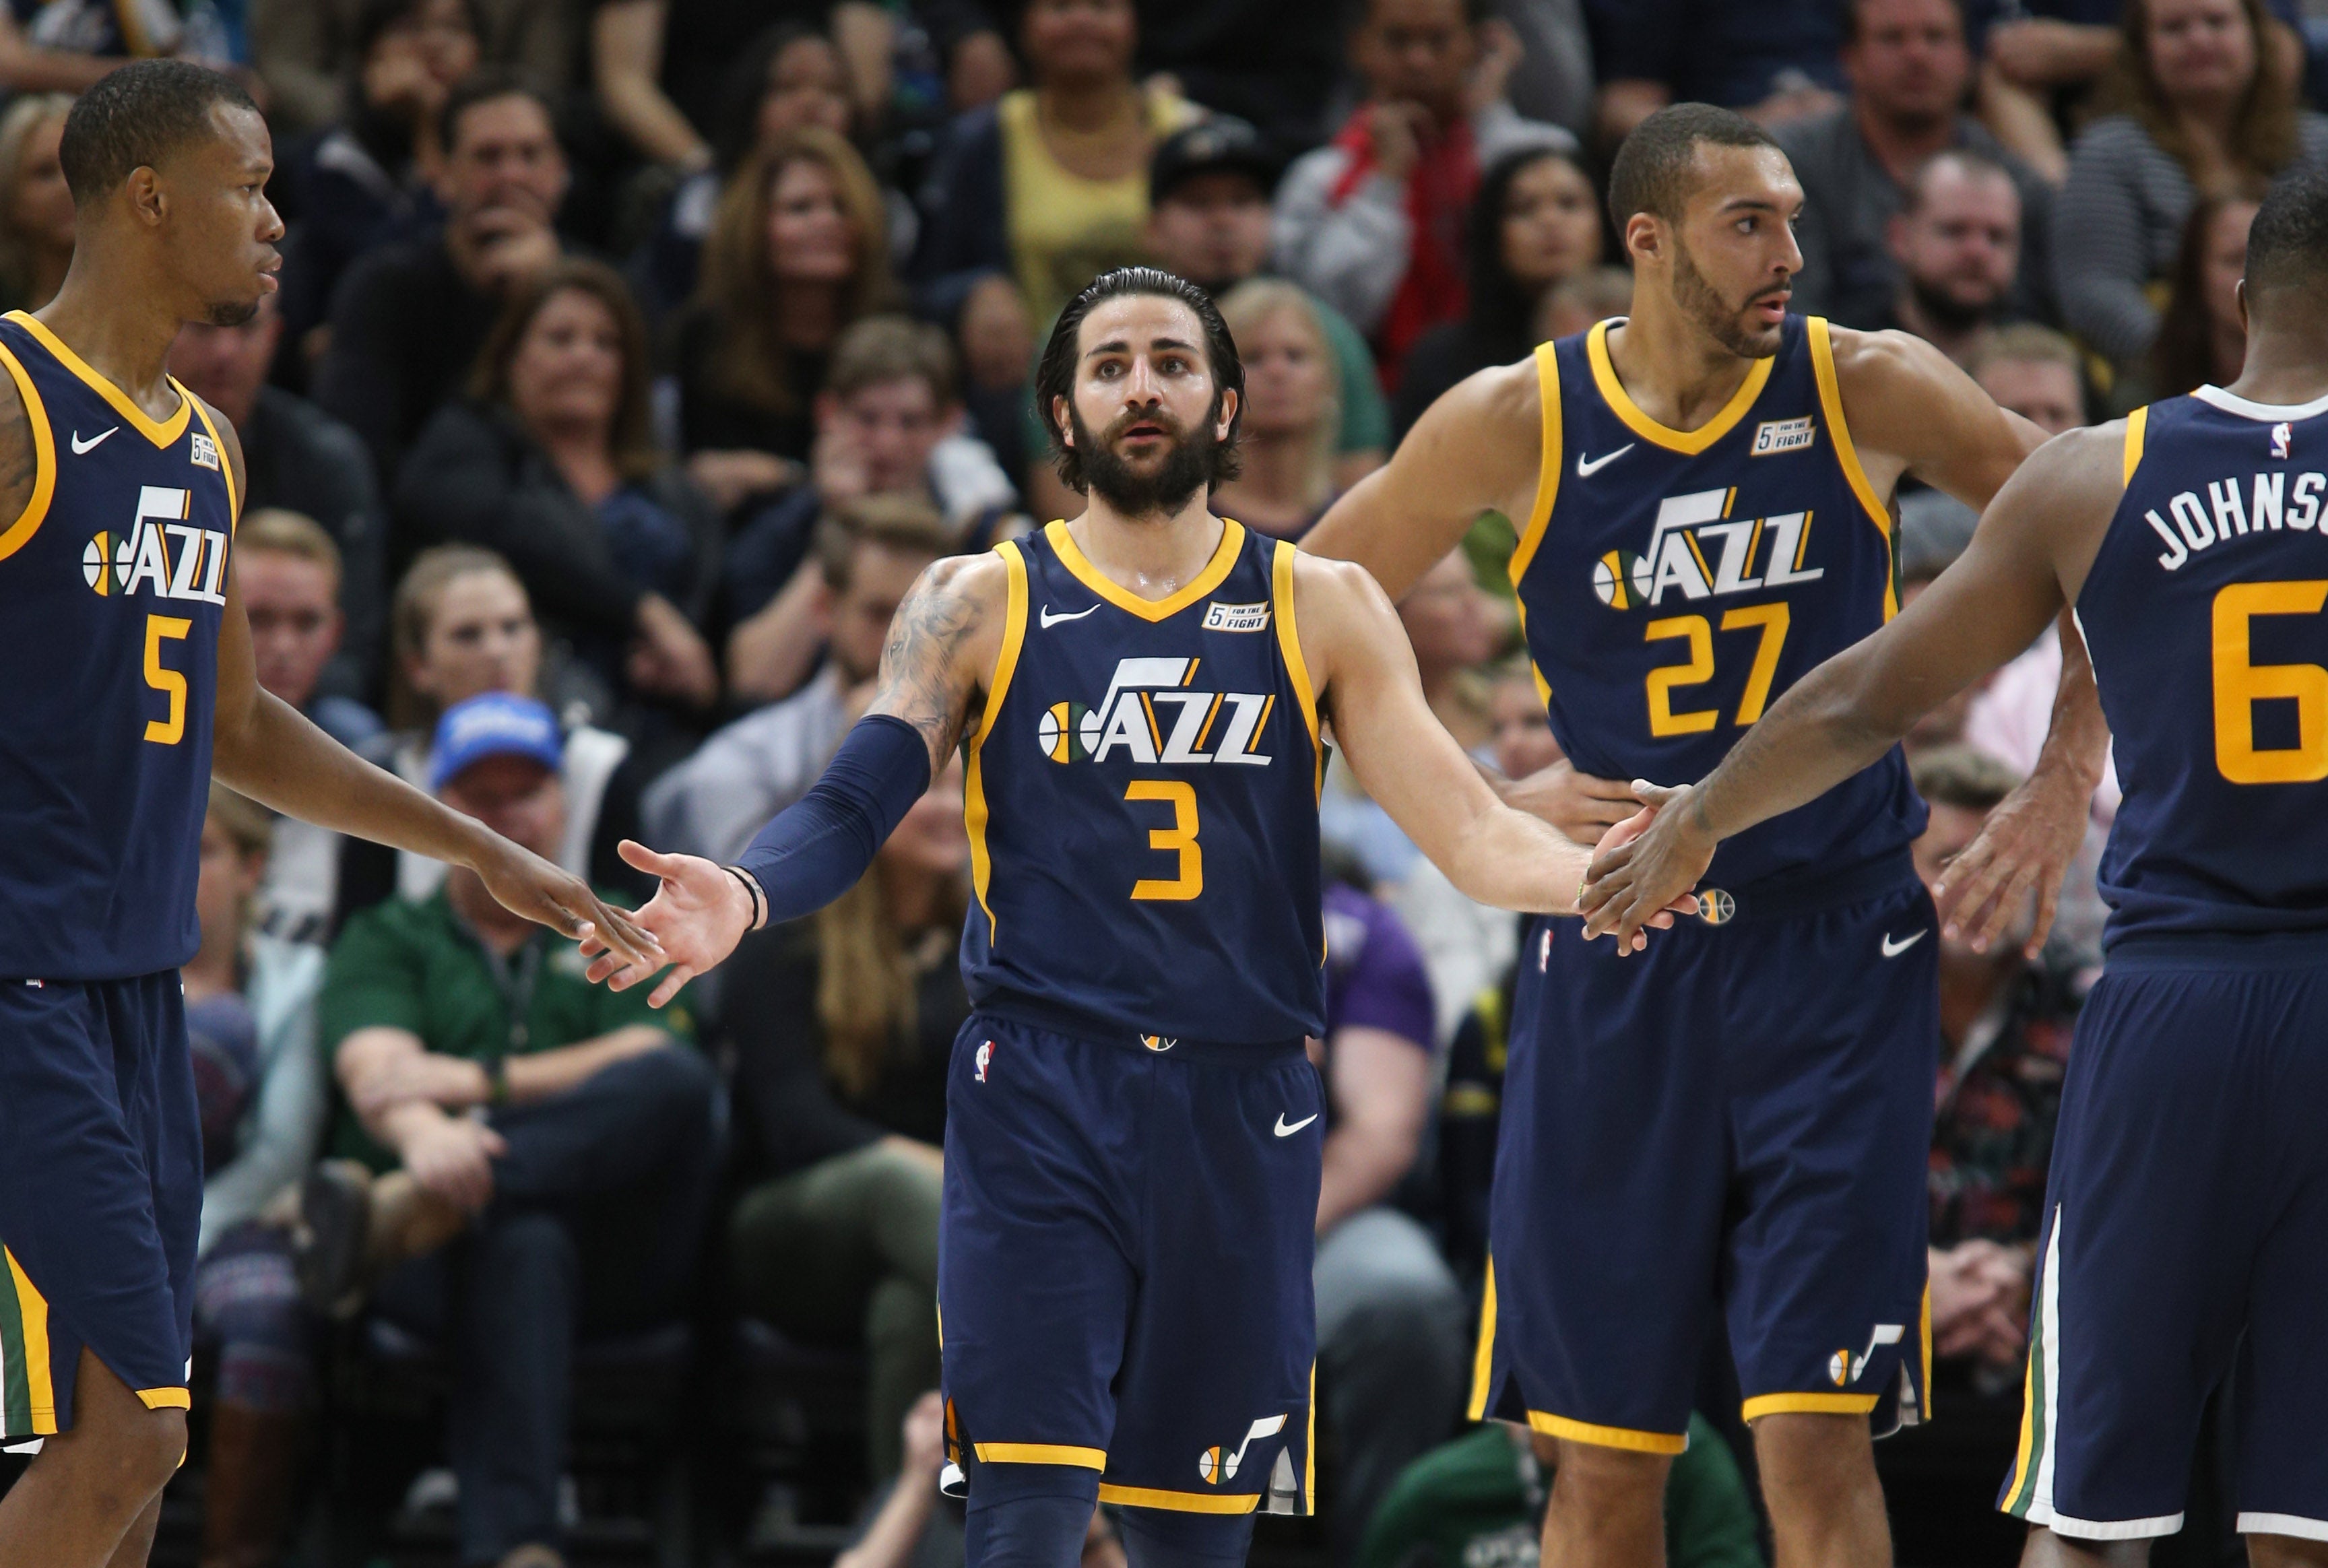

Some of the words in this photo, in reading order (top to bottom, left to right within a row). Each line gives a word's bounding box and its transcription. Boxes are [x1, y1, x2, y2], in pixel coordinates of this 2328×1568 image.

[194, 437, 201, 460] 5
[1758, 426, 1773, 450] 5
[1775, 432, 1811, 448] FIGHT
[83, 486, 228, 606] JAZZ
[1593, 486, 1824, 611] JAZZ
[2144, 471, 2328, 571] JOHNS
[1209, 607, 1225, 626] 5
[1227, 617, 1264, 628] FIGHT
[1644, 601, 1791, 738] 27
[143, 613, 193, 746] 5
[1039, 657, 1276, 766] JAZZ
[2212, 580, 2328, 785] 6
[1124, 780, 1204, 901] 3
